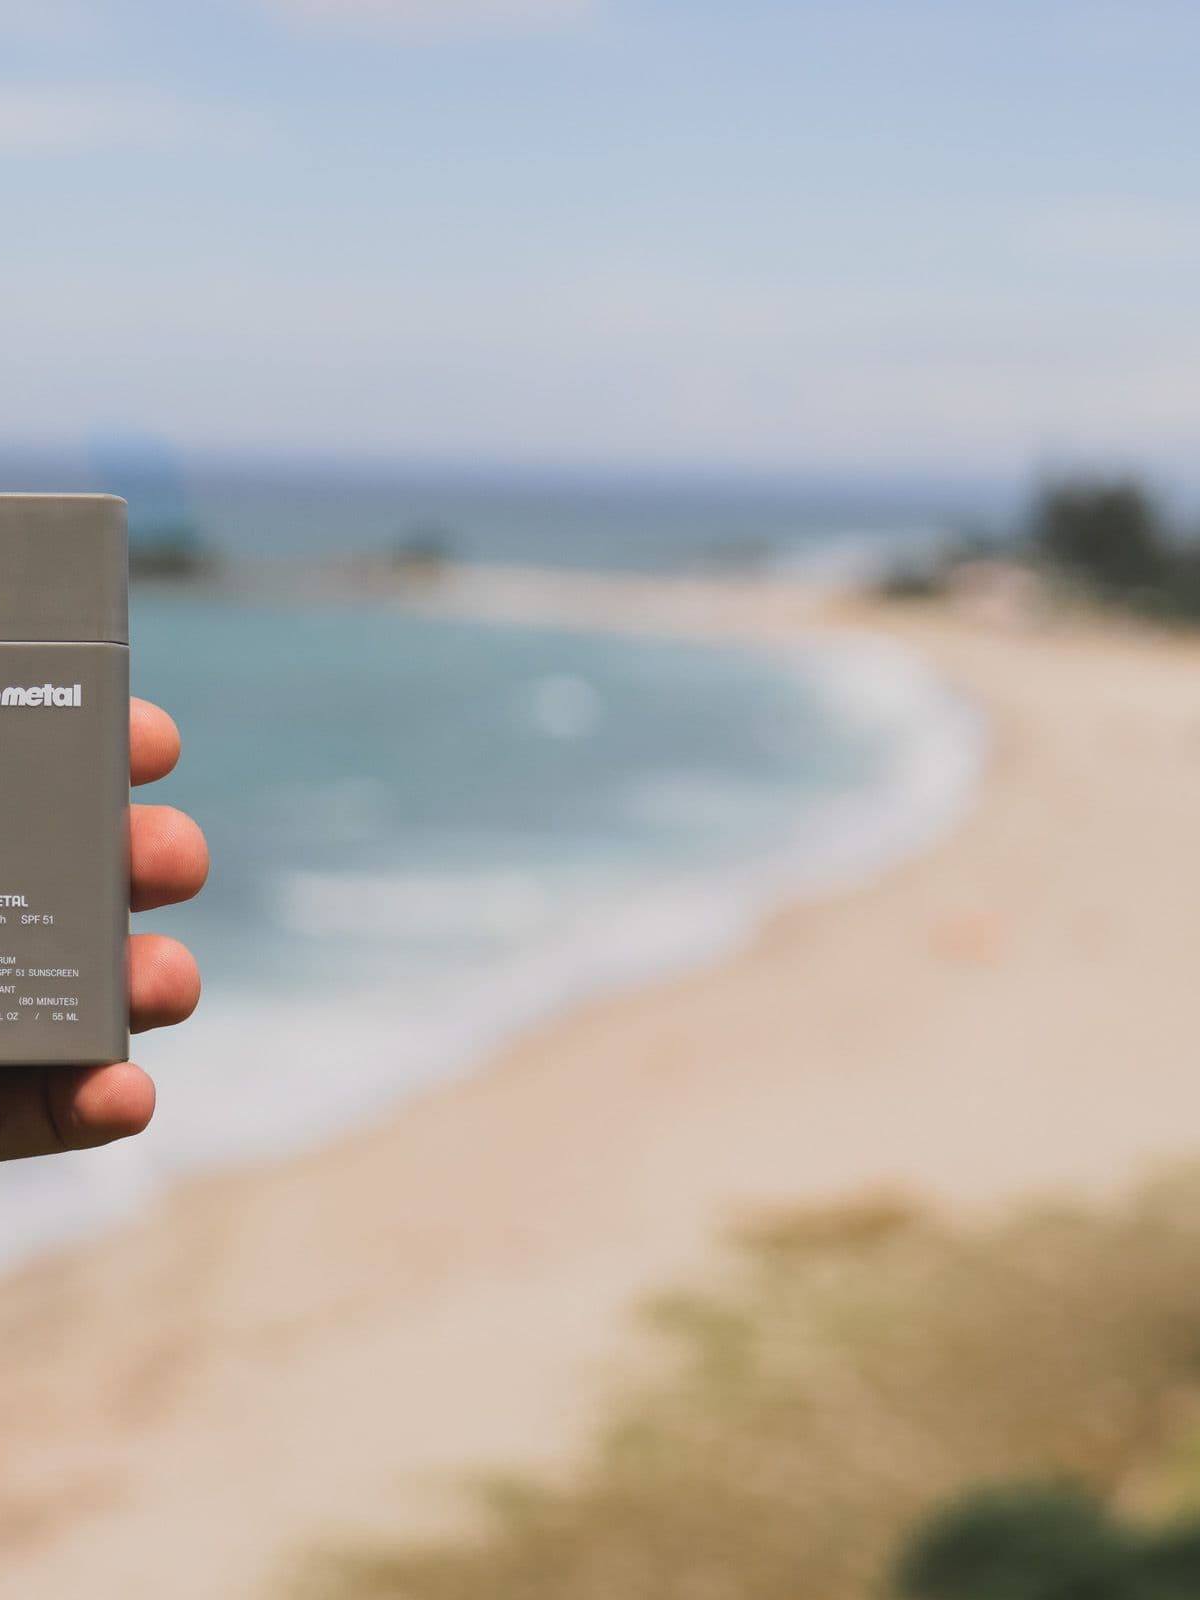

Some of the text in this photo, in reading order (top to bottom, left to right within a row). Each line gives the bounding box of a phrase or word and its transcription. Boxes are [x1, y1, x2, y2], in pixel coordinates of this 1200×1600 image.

[21, 914, 40, 924] SPF
[42, 914, 54, 924] 51
[15, 968, 25, 977] 51
[28, 968, 79, 977] SUNSCREEN
[18, 997, 79, 1006] (80 MINUTES)
[6, 1012, 19, 1021] OZ
[66, 1012, 79, 1021] ML
